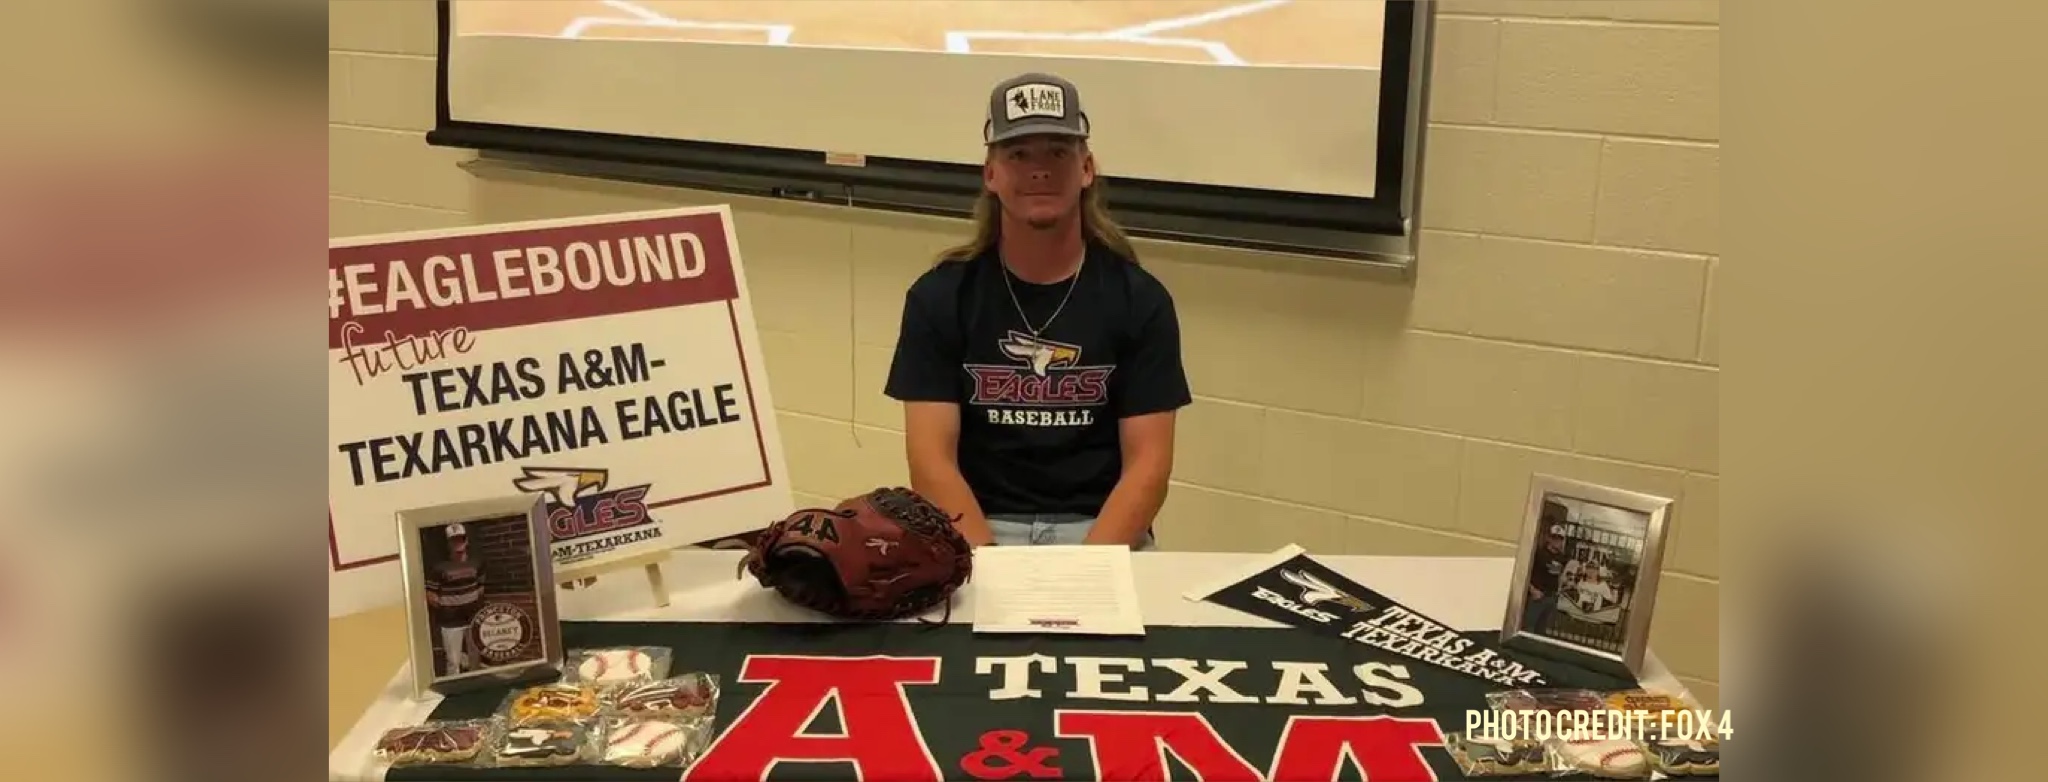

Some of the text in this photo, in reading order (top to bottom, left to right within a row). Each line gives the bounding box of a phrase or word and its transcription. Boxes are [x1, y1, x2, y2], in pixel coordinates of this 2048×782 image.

[329, 231, 707, 319] #EAGLEBOUND
[339, 321, 477, 386] future
[402, 342, 667, 416] TEXAS A&M-
[970, 367, 1110, 404] EAGLES
[338, 383, 741, 486] TEXARKANA EAGLE
[987, 409, 1094, 427] BASEBALL
[548, 486, 648, 539] GLES
[1250, 586, 1342, 624] EAGLES
[1340, 620, 1515, 687] TEXARKANA
[1366, 605, 1547, 686] TEXAS A&M-
[974, 652, 1425, 708] TEXAS
